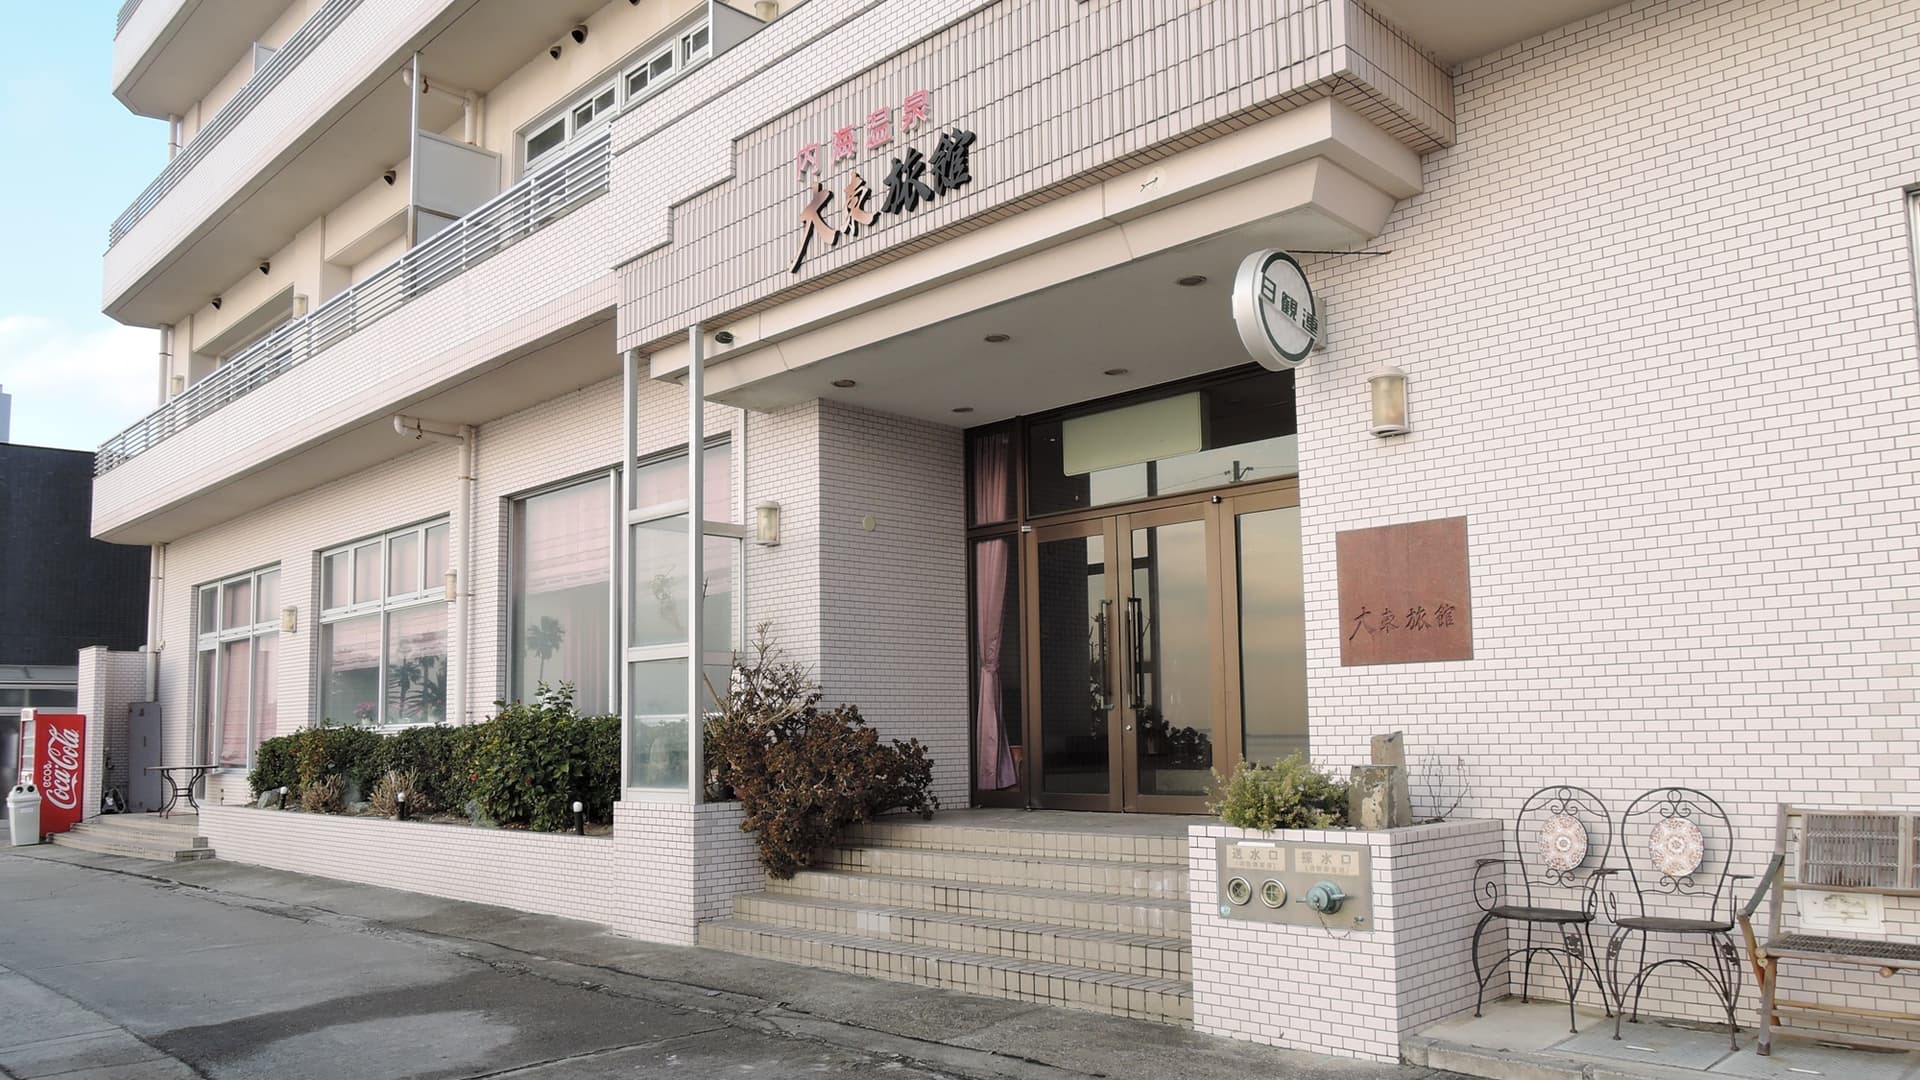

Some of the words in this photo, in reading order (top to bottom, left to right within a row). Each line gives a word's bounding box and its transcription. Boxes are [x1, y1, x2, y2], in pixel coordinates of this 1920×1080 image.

[789, 128, 976, 273] 大東旅館
[1348, 603, 1456, 641] 大東旅館
[46, 724, 80, 809] Coca-Cola
